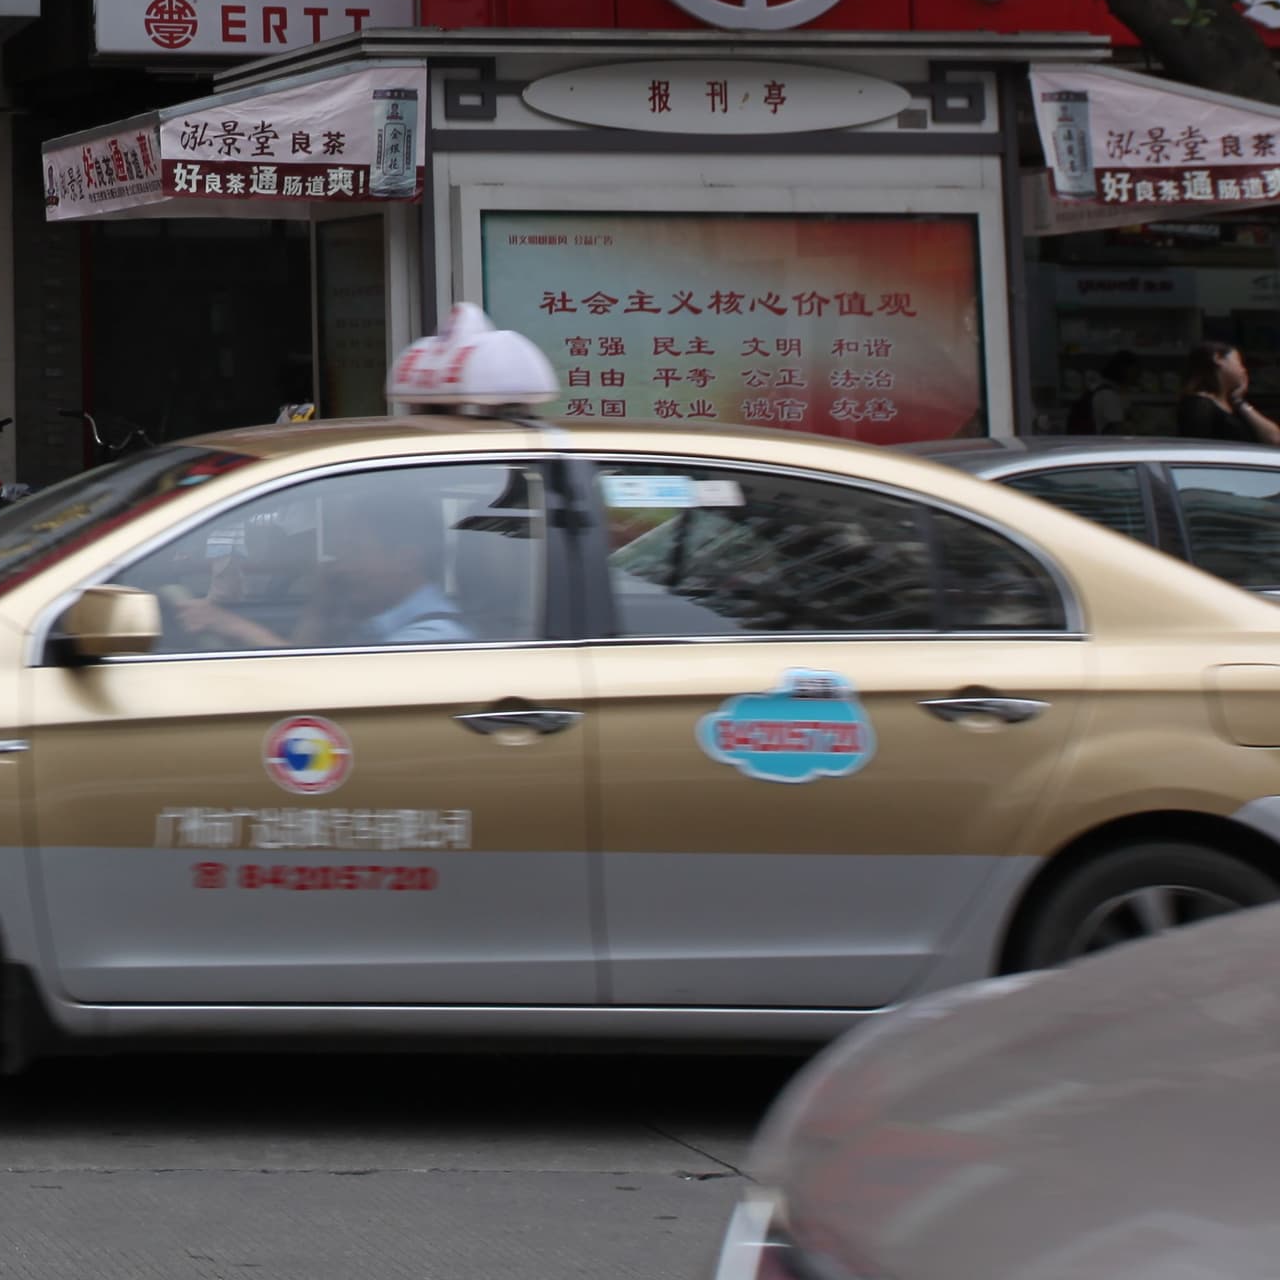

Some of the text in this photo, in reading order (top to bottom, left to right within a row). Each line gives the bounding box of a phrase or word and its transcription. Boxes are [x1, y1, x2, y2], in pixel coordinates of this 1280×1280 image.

[221, 5, 371, 44] ERTT
[648, 79, 787, 114] 报刊亭
[539, 289, 918, 318] 社会主义核心价值观
[565, 336, 893, 359] 富强 民主 文明 和谐
[568, 366, 894, 389] 自由 平等 公正 法治
[565, 397, 897, 420] 爱国 敬业 诚信 友善
